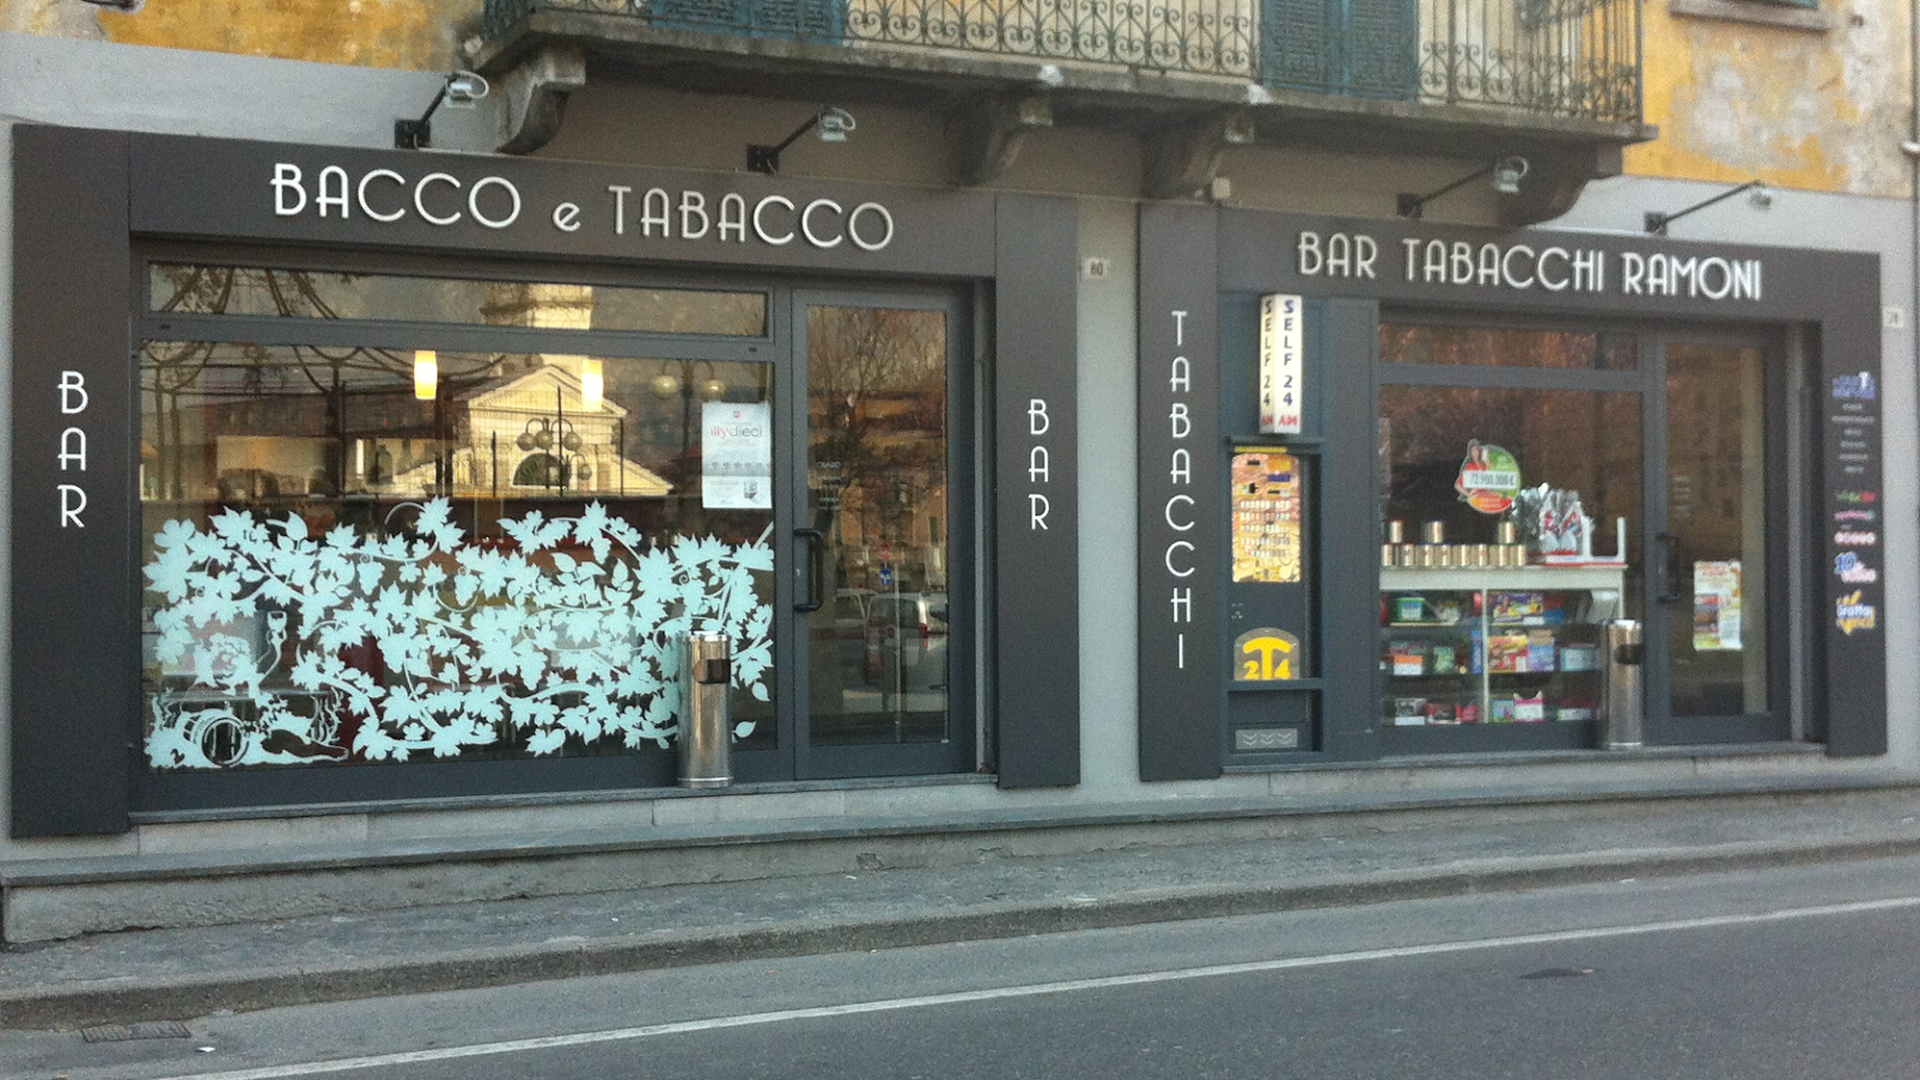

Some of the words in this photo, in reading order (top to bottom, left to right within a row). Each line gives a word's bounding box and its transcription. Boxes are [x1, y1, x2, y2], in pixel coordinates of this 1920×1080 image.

[270, 163, 521, 230] BACCO
[552, 201, 581, 232] e
[608, 186, 894, 251] TABACCO
[1298, 231, 1378, 279] BAR
[1402, 238, 1603, 292] TABACCHI
[1621, 251, 1763, 300] RAMONI
[1283, 299, 1294, 367] SELF
[1283, 374, 1293, 406] 24
[57, 370, 89, 528] BAR
[1028, 398, 1050, 530] BAR
[1165, 310, 1195, 669] TABACCHI
